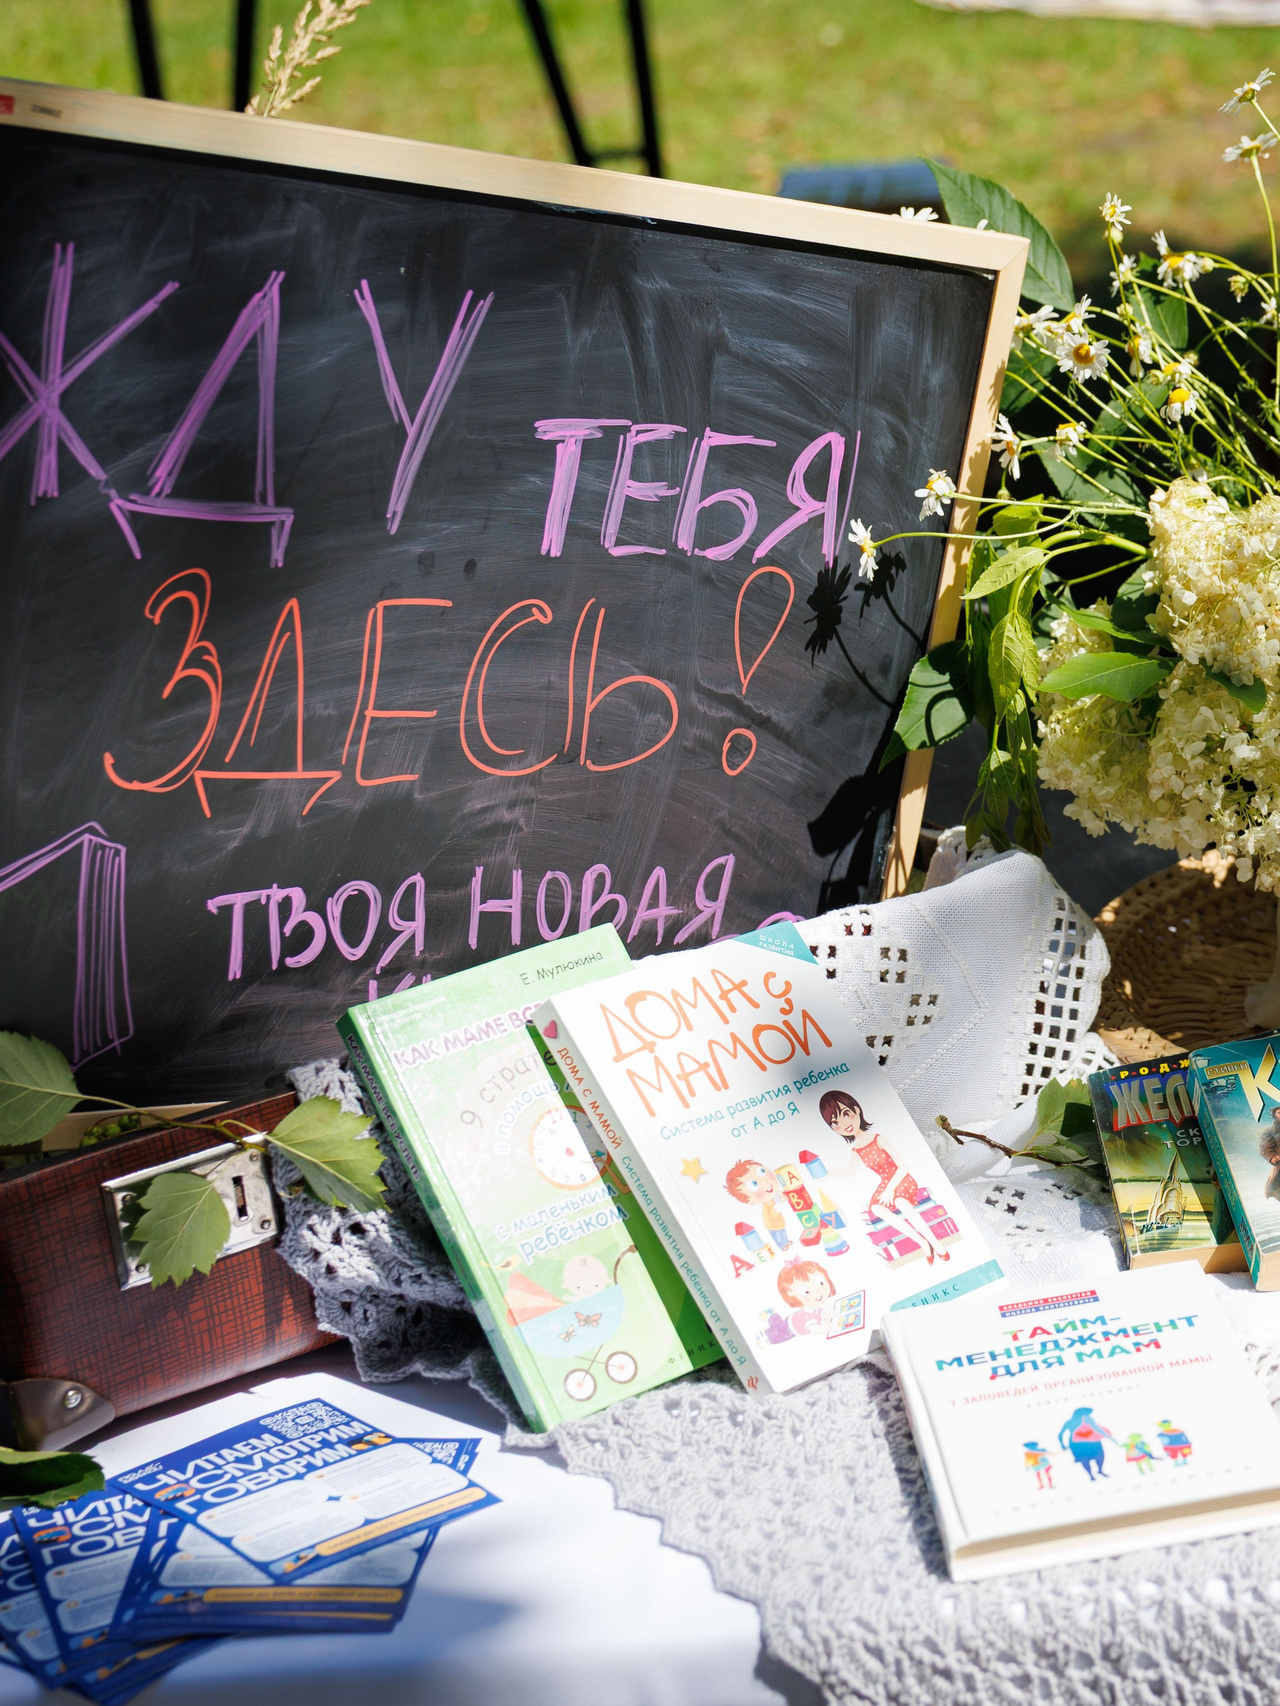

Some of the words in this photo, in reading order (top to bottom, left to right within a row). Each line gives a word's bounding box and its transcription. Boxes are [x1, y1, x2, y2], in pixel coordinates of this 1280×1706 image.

[0, 242, 494, 567] ЖДУ
[534, 418, 861, 568] ТЕБЯ
[208, 873, 425, 982] ТВОЯ
[470, 853, 735, 950] НОВАЯ
[759, 934, 795, 949] ШКОЛА
[520, 971, 535, 986] Е.
[536, 951, 604, 982] Мулюкина
[758, 942, 795, 957] РАЗВИТИЯ
[393, 1039, 441, 1068] КАК
[442, 1016, 509, 1052] МАМЕ
[600, 969, 760, 1063] ДОМА
[625, 998, 833, 1118] МАМОЙ
[1206, 1063, 1249, 1077] СТИВЕН
[346, 1034, 365, 1067] КАК
[361, 1064, 385, 1109] МАМЕ
[393, 1131, 421, 1183] УСПЕТЬ
[460, 1109, 483, 1129] 9
[499, 1081, 559, 1138] помощь
[660, 1108, 725, 1141] Система
[728, 1082, 792, 1122] развития
[793, 1062, 850, 1094] ребенка
[731, 1124, 748, 1139] от
[767, 1109, 786, 1126] до
[787, 1101, 801, 1116] Я
[512, 1181, 618, 1231] маленьким
[519, 1203, 630, 1260] ребёнком
[557, 1047, 584, 1088] ДОМА
[589, 1100, 624, 1150] МАМОЙ
[622, 1156, 654, 1207] Система
[648, 1206, 685, 1260] развития
[679, 1259, 713, 1309] ребенка
[710, 1307, 721, 1323] от
[725, 1338, 739, 1354] до
[736, 1355, 747, 1366] Я
[902, 1284, 960, 1309] ЕНИКС
[935, 1314, 1199, 1371] МЕНЕДЖМЕНТ
[1002, 1315, 1121, 1341] ТАЙМ-
[963, 1382, 1041, 1405] ЗАПОВЕДЕЙ
[1043, 1362, 1166, 1391] ОРГАНИЗОВАННОЙ
[1169, 1354, 1214, 1368] МАМЫ
[989, 1354, 1065, 1381] ДЛЯ
[1075, 1338, 1162, 1364] МАМ
[133, 1433, 283, 1490] ЧИТАЕМ
[174, 1444, 358, 1514] ГОВОРИМ
[188, 1421, 374, 1489] СМОТРИМ
